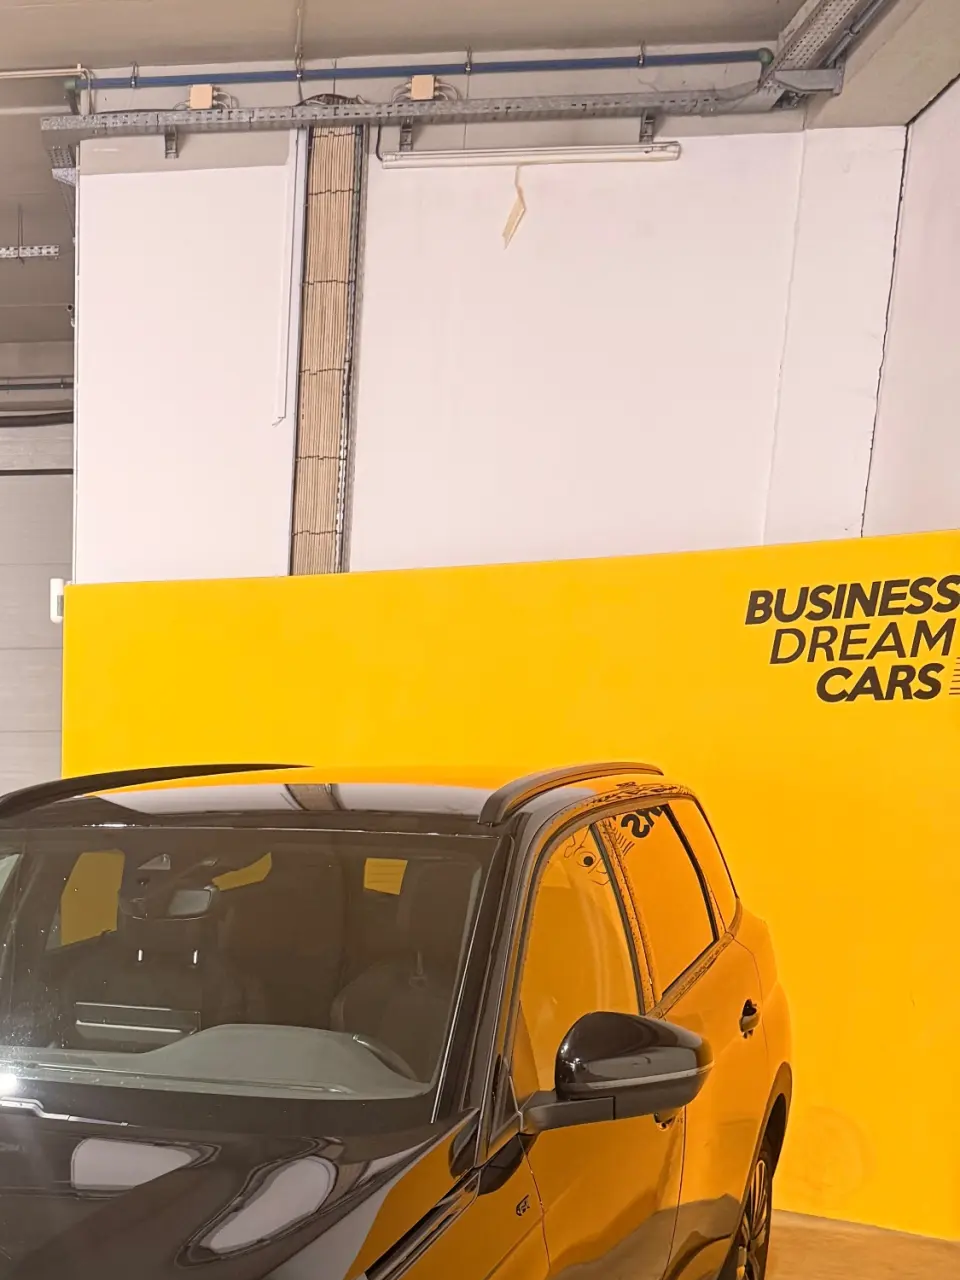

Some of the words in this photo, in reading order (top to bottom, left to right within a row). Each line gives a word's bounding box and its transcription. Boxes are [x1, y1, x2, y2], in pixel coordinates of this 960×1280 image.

[744, 574, 960, 625] BUSINESS
[769, 618, 957, 664] DREAM
[816, 662, 945, 703] CARS
